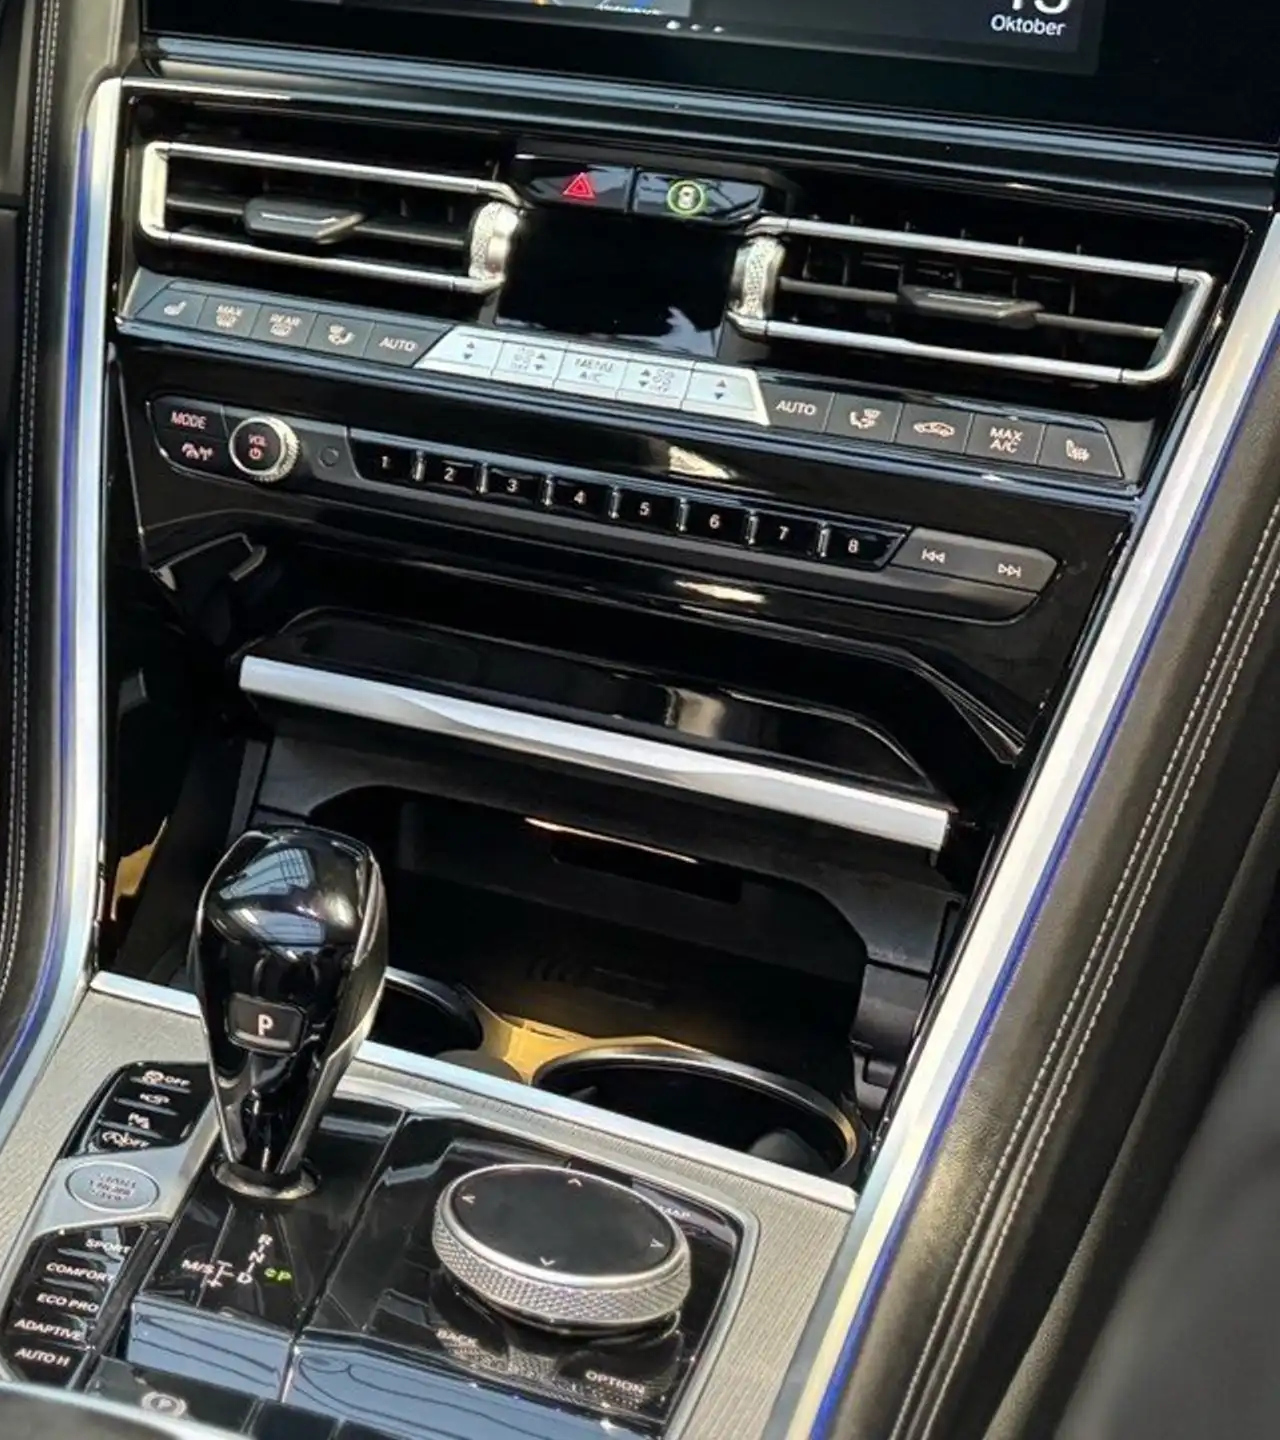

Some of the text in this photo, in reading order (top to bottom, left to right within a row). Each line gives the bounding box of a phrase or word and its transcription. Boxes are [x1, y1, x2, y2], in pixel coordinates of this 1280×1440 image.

[990, 14, 1067, 36] Oktober
[378, 335, 419, 353] AUTO
[776, 399, 817, 416] AUTO
[171, 411, 208, 430] MODE
[989, 427, 1024, 443] MAX
[989, 439, 1019, 454] A/C
[381, 455, 859, 553] 1 2 3 4 5 6 7 8
[257, 1013, 274, 1036] P
[164, 1075, 191, 1087] OFF
[84, 1238, 132, 1255] SPORT
[248, 1250, 265, 1264] N
[45, 1262, 115, 1282] COMFORT
[36, 1292, 100, 1313] ECO PRO
[14, 1318, 85, 1342] ADAPTIVE
[14, 1347, 71, 1367] AUTO H
[585, 1370, 646, 1395] OPTION
